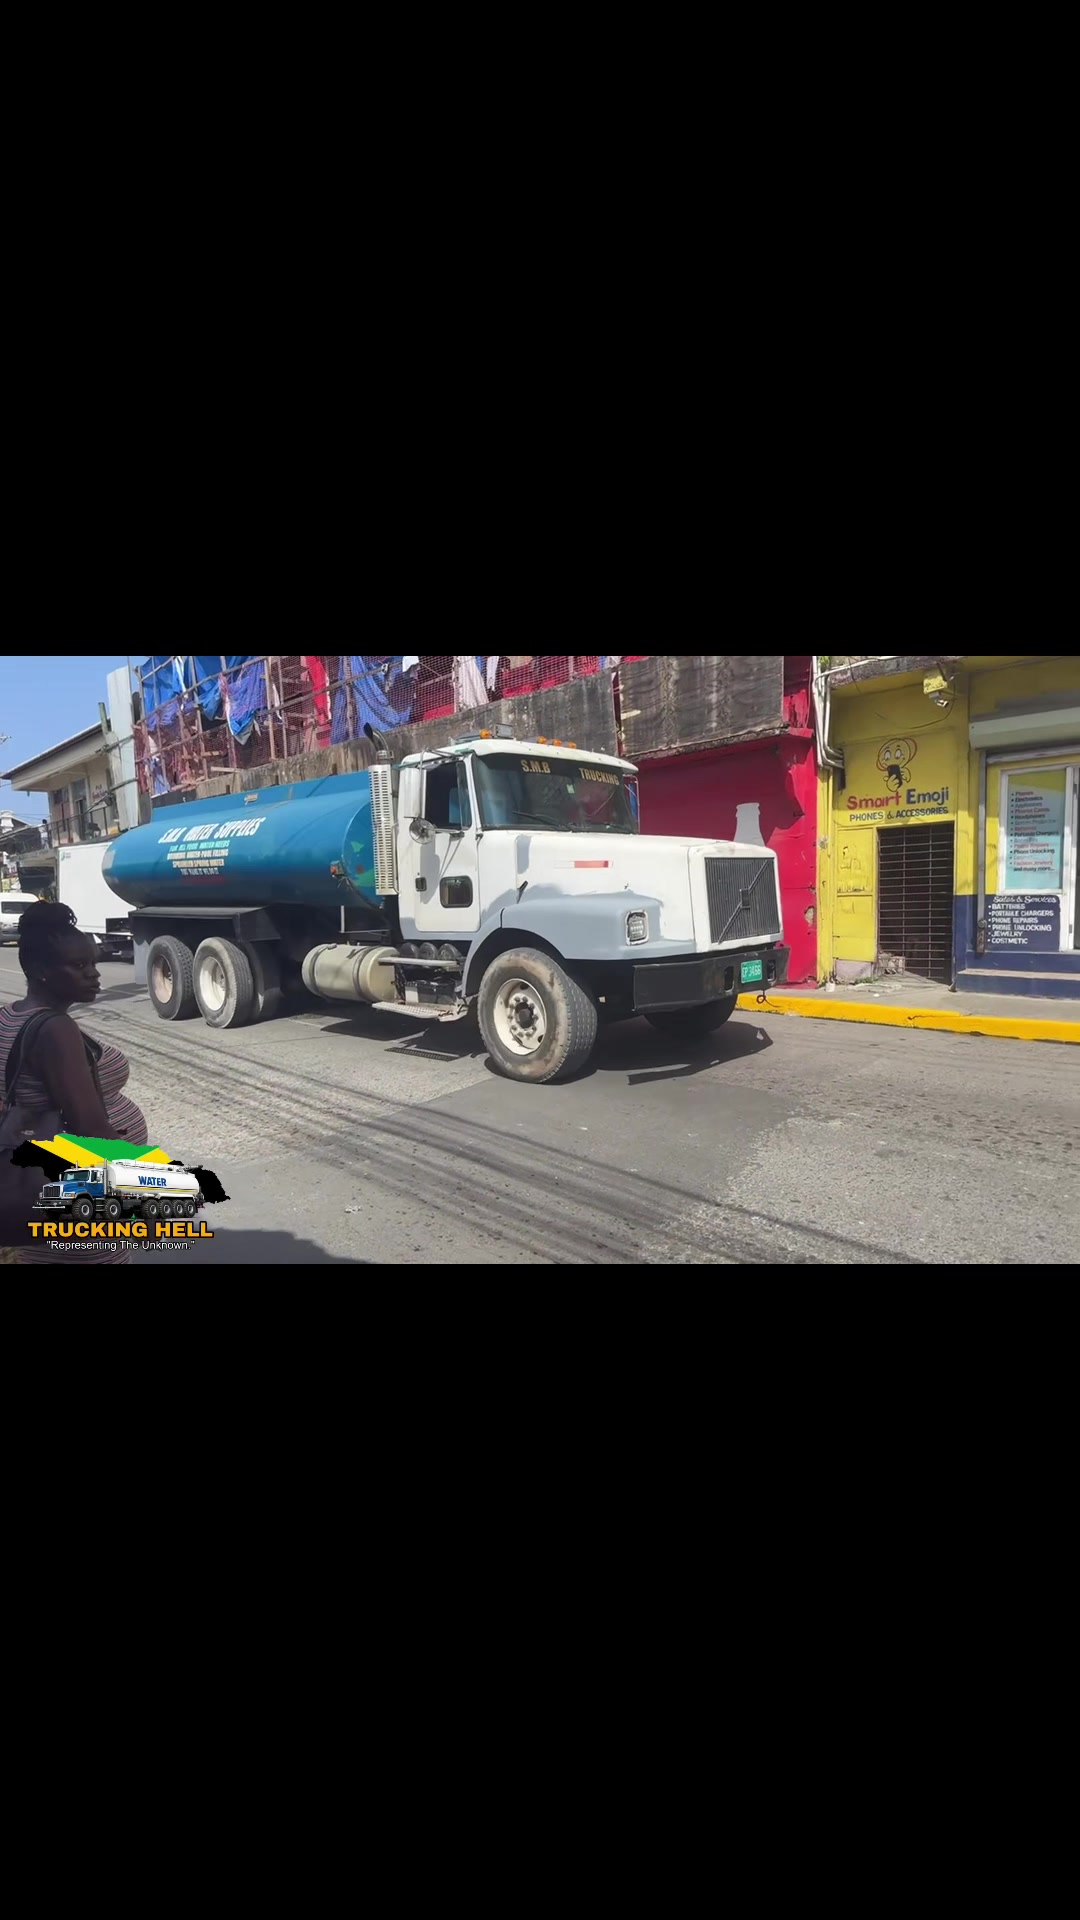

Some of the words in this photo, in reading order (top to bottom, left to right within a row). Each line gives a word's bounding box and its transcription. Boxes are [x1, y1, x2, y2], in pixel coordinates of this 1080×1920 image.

[521, 760, 551, 774] S.M.B
[579, 768, 620, 785] TRUCKING
[847, 791, 902, 810] Smart
[906, 787, 949, 805] Emoji
[850, 811, 884, 822] PHONES
[887, 811, 894, 819] &
[896, 806, 949, 818] ACCESSORIES
[183, 823, 220, 841] WATER
[213, 817, 267, 839] SUPPLIES
[1024, 895, 1057, 904] Services
[1014, 924, 1052, 932] UNLOCKING
